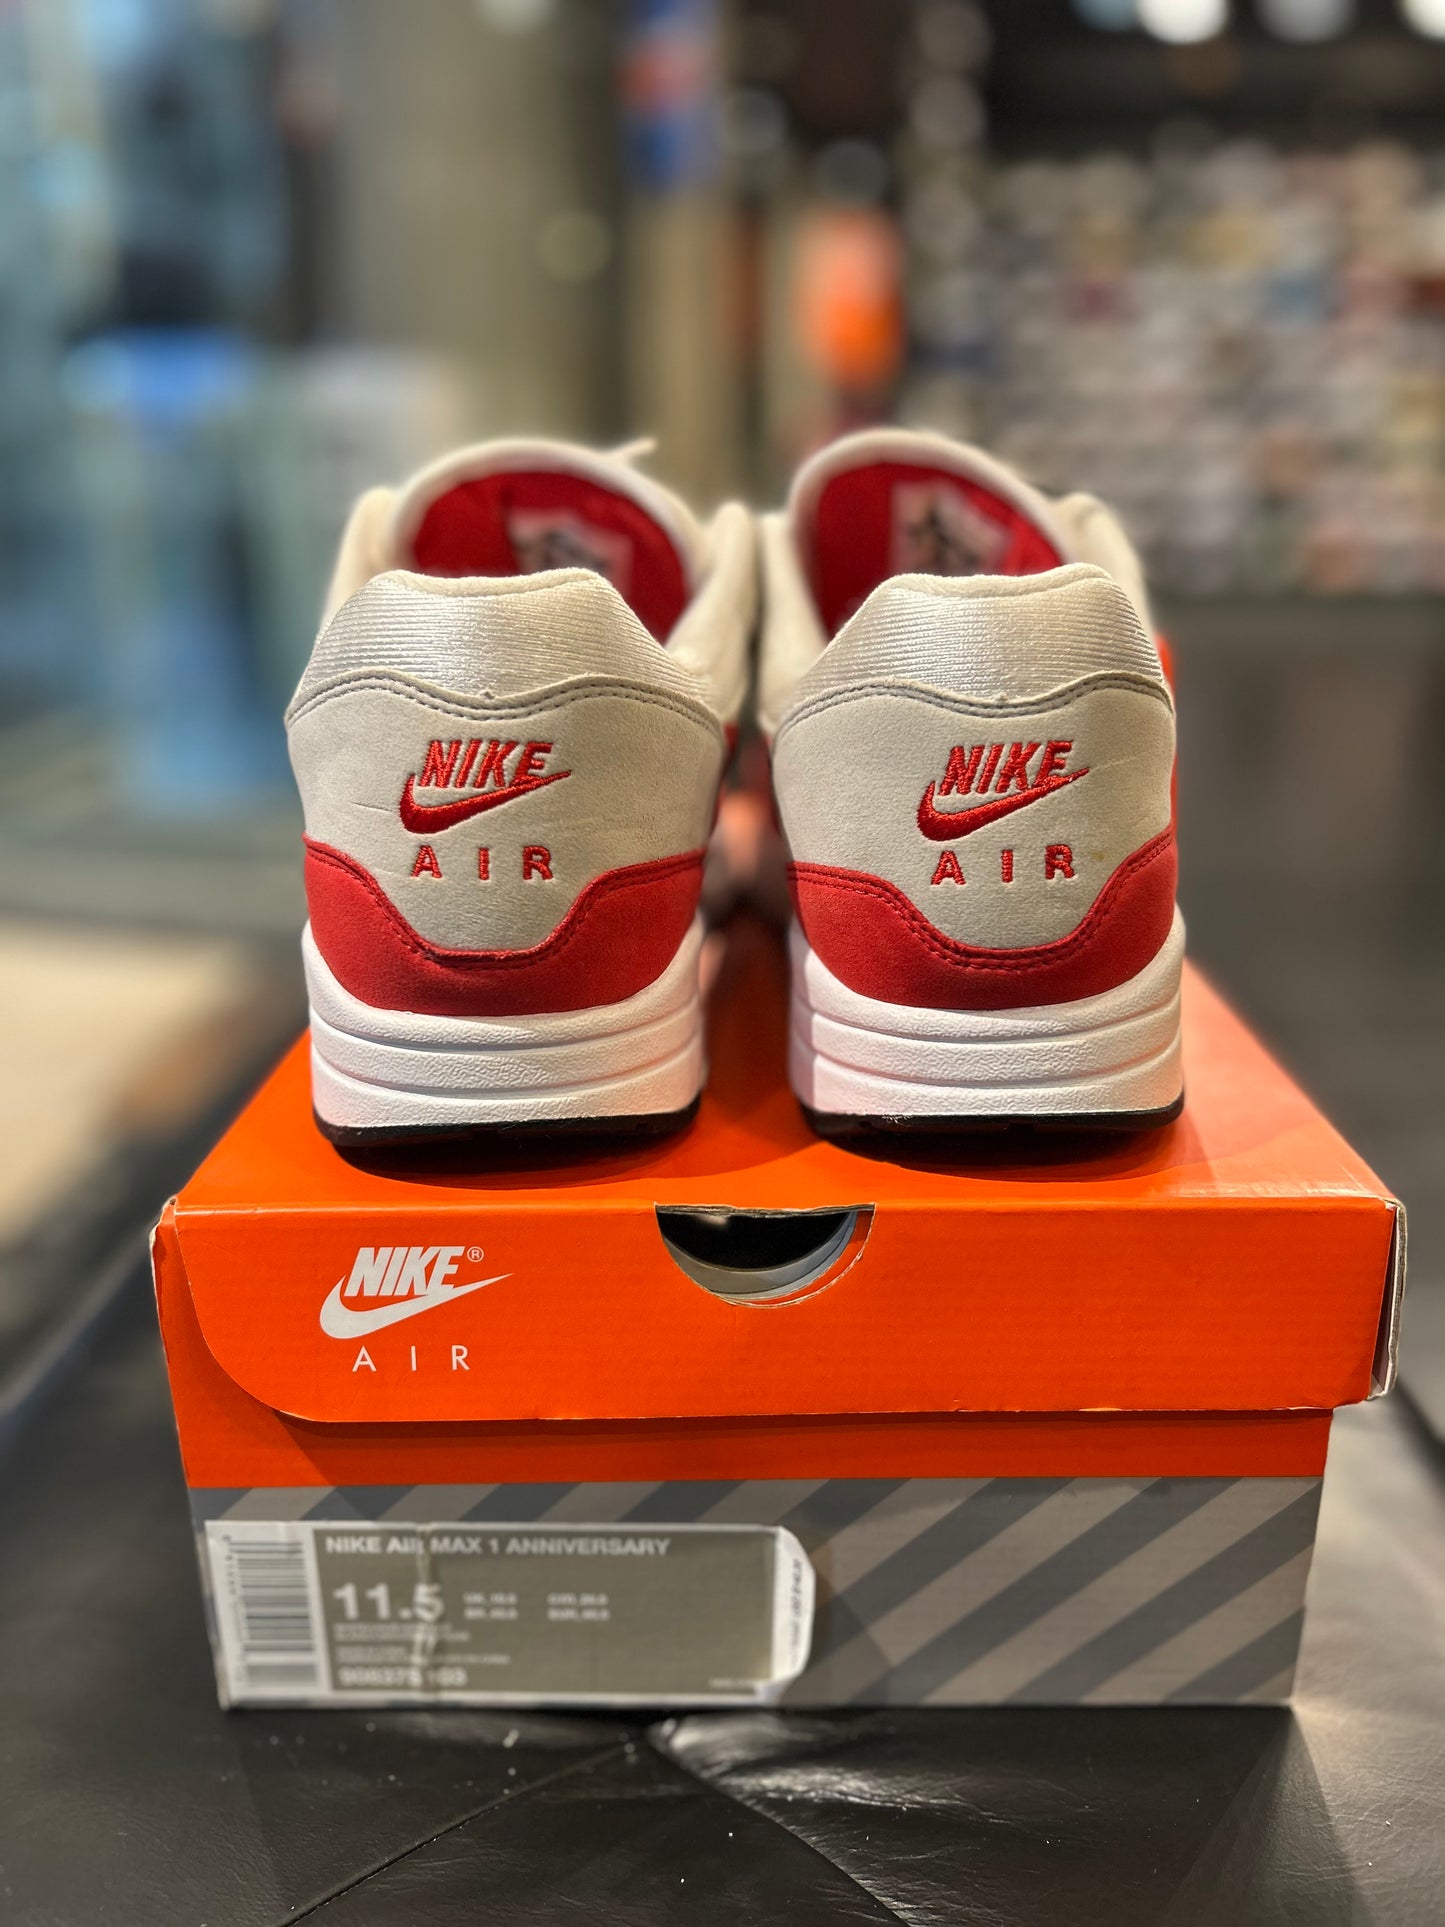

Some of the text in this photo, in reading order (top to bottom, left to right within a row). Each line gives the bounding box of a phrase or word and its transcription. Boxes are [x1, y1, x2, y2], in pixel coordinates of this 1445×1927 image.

[417, 739, 553, 789] NIKE
[938, 740, 1073, 796] NIKE
[411, 845, 554, 881] AIR
[930, 843, 1075, 886] AIR
[352, 1344, 470, 1372] AIR
[324, 1536, 671, 1555] NIKE AIR MAX 1 ANNIVERSARY
[333, 1582, 445, 1622] 11.5
